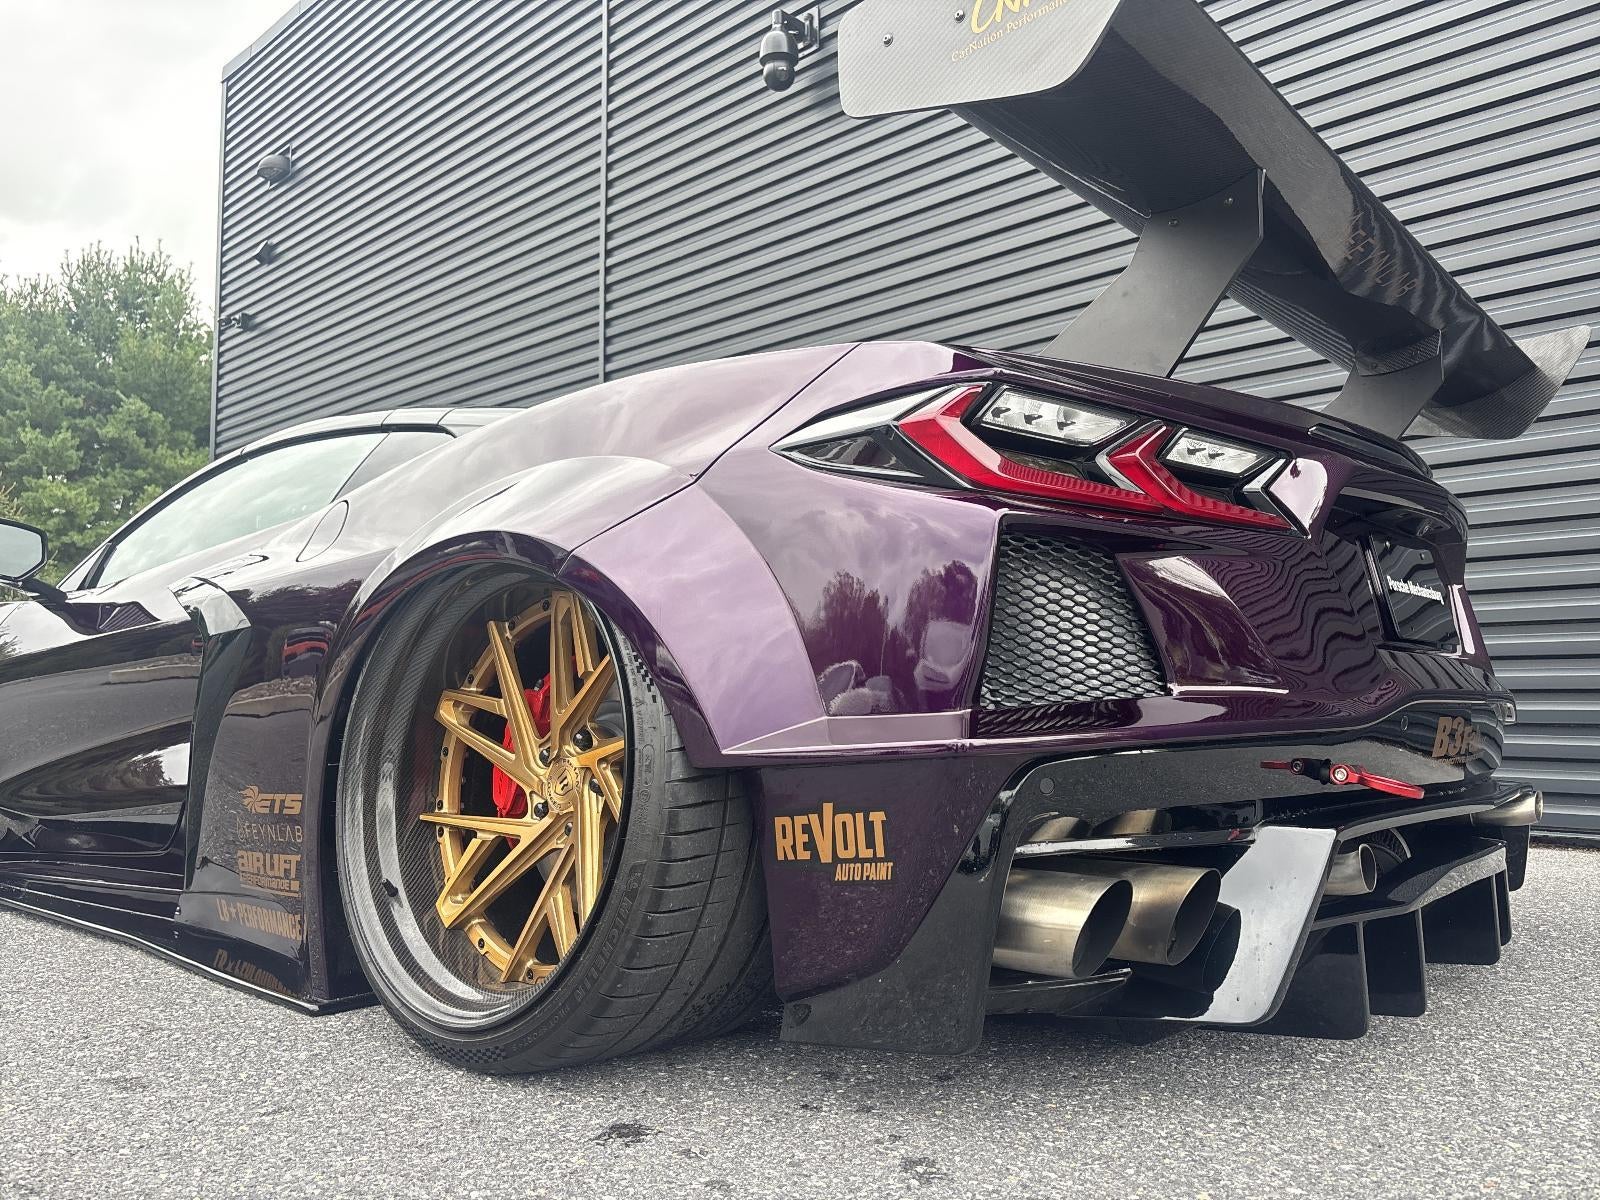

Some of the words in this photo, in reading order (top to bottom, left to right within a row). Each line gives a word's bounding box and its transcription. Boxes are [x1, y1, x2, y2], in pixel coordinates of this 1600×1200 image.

[951, 29, 1004, 62] CarNation
[244, 821, 303, 843] FEYNLAB
[774, 802, 887, 864] REVOLT
[834, 863, 861, 882] AUTO
[862, 862, 893, 881] PAINT
